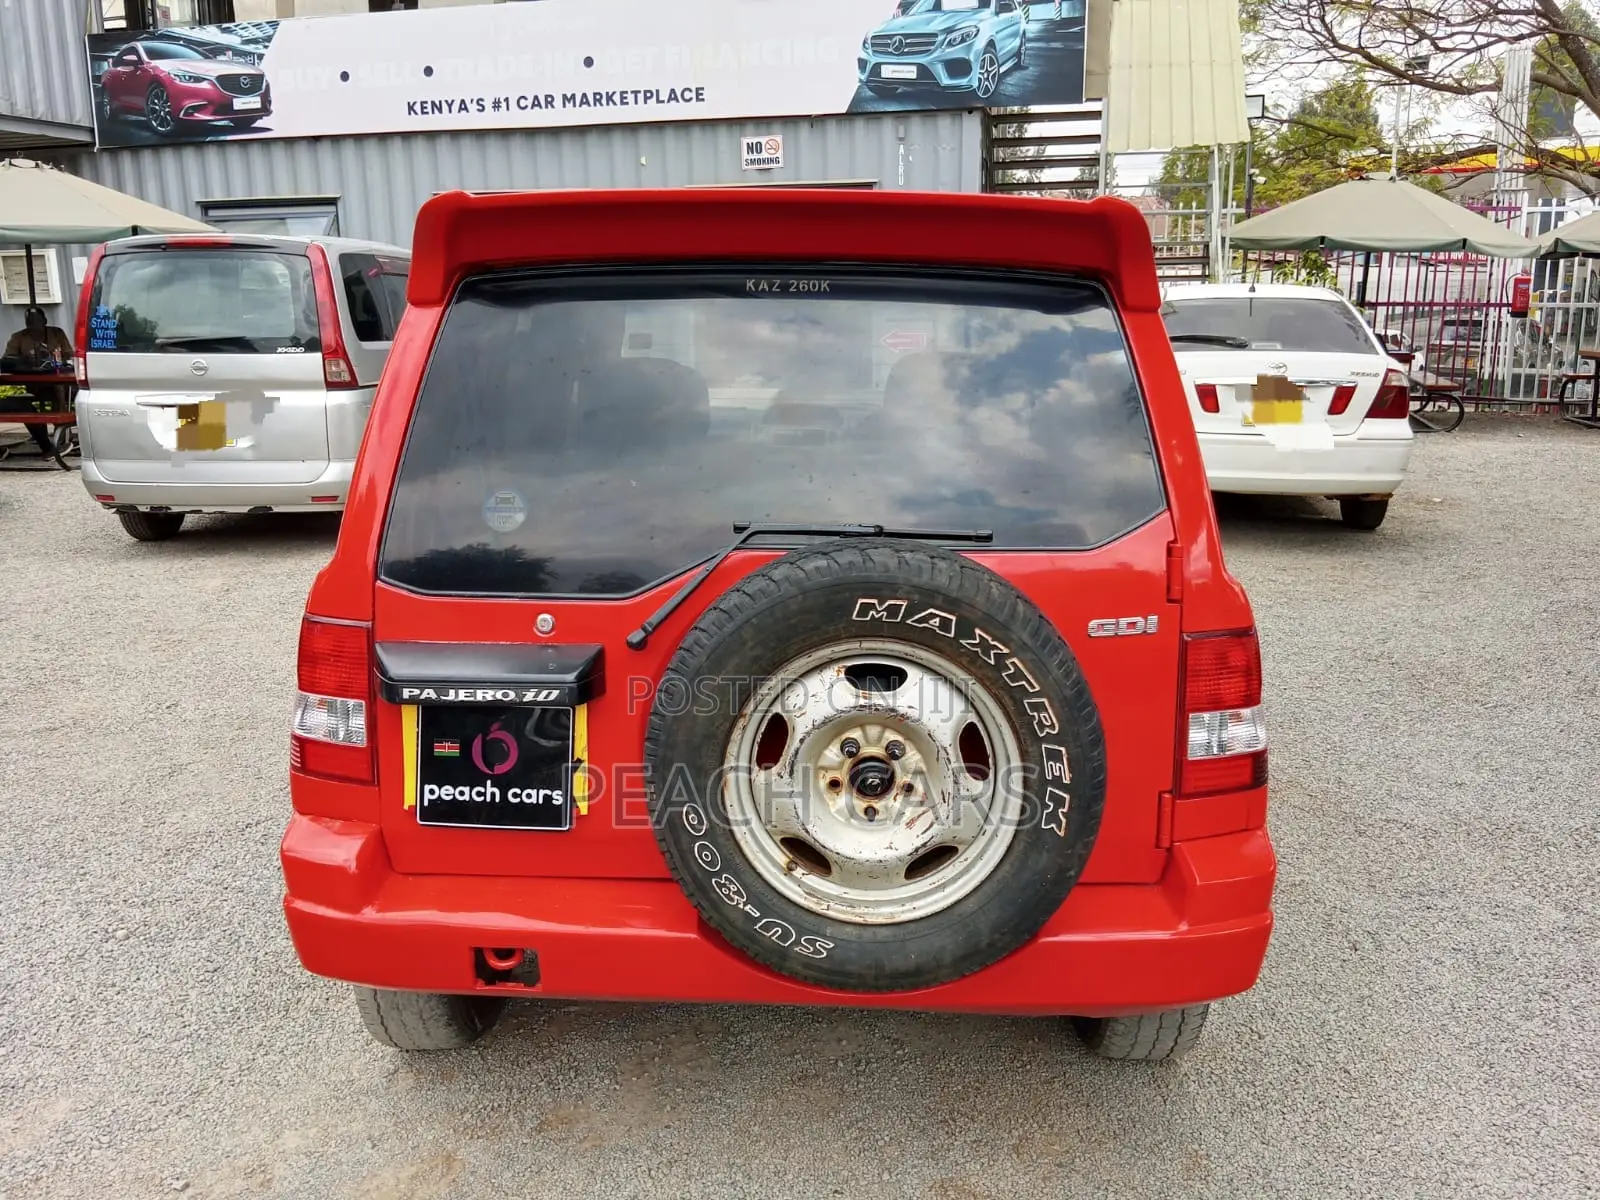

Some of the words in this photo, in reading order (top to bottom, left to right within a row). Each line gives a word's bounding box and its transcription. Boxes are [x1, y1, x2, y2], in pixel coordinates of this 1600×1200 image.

[407, 97, 486, 116] KENYA'S
[491, 96, 511, 113] #1
[516, 94, 556, 111] CAR
[562, 86, 706, 109] MARKETPLACE
[746, 141, 763, 155] NO
[745, 156, 780, 167] SMOKING
[746, 279, 781, 293] KAZ
[788, 279, 830, 293] 260K
[91, 317, 117, 329] STAND
[95, 329, 117, 339] WITH
[90, 337, 117, 349] ISRAEL
[1087, 615, 1159, 637] GDI
[402, 687, 516, 701] PAJERO
[852, 598, 1072, 837] MAXTREK
[423, 780, 501, 807] peach
[507, 787, 564, 805] cars
[682, 802, 835, 959] SU-800
